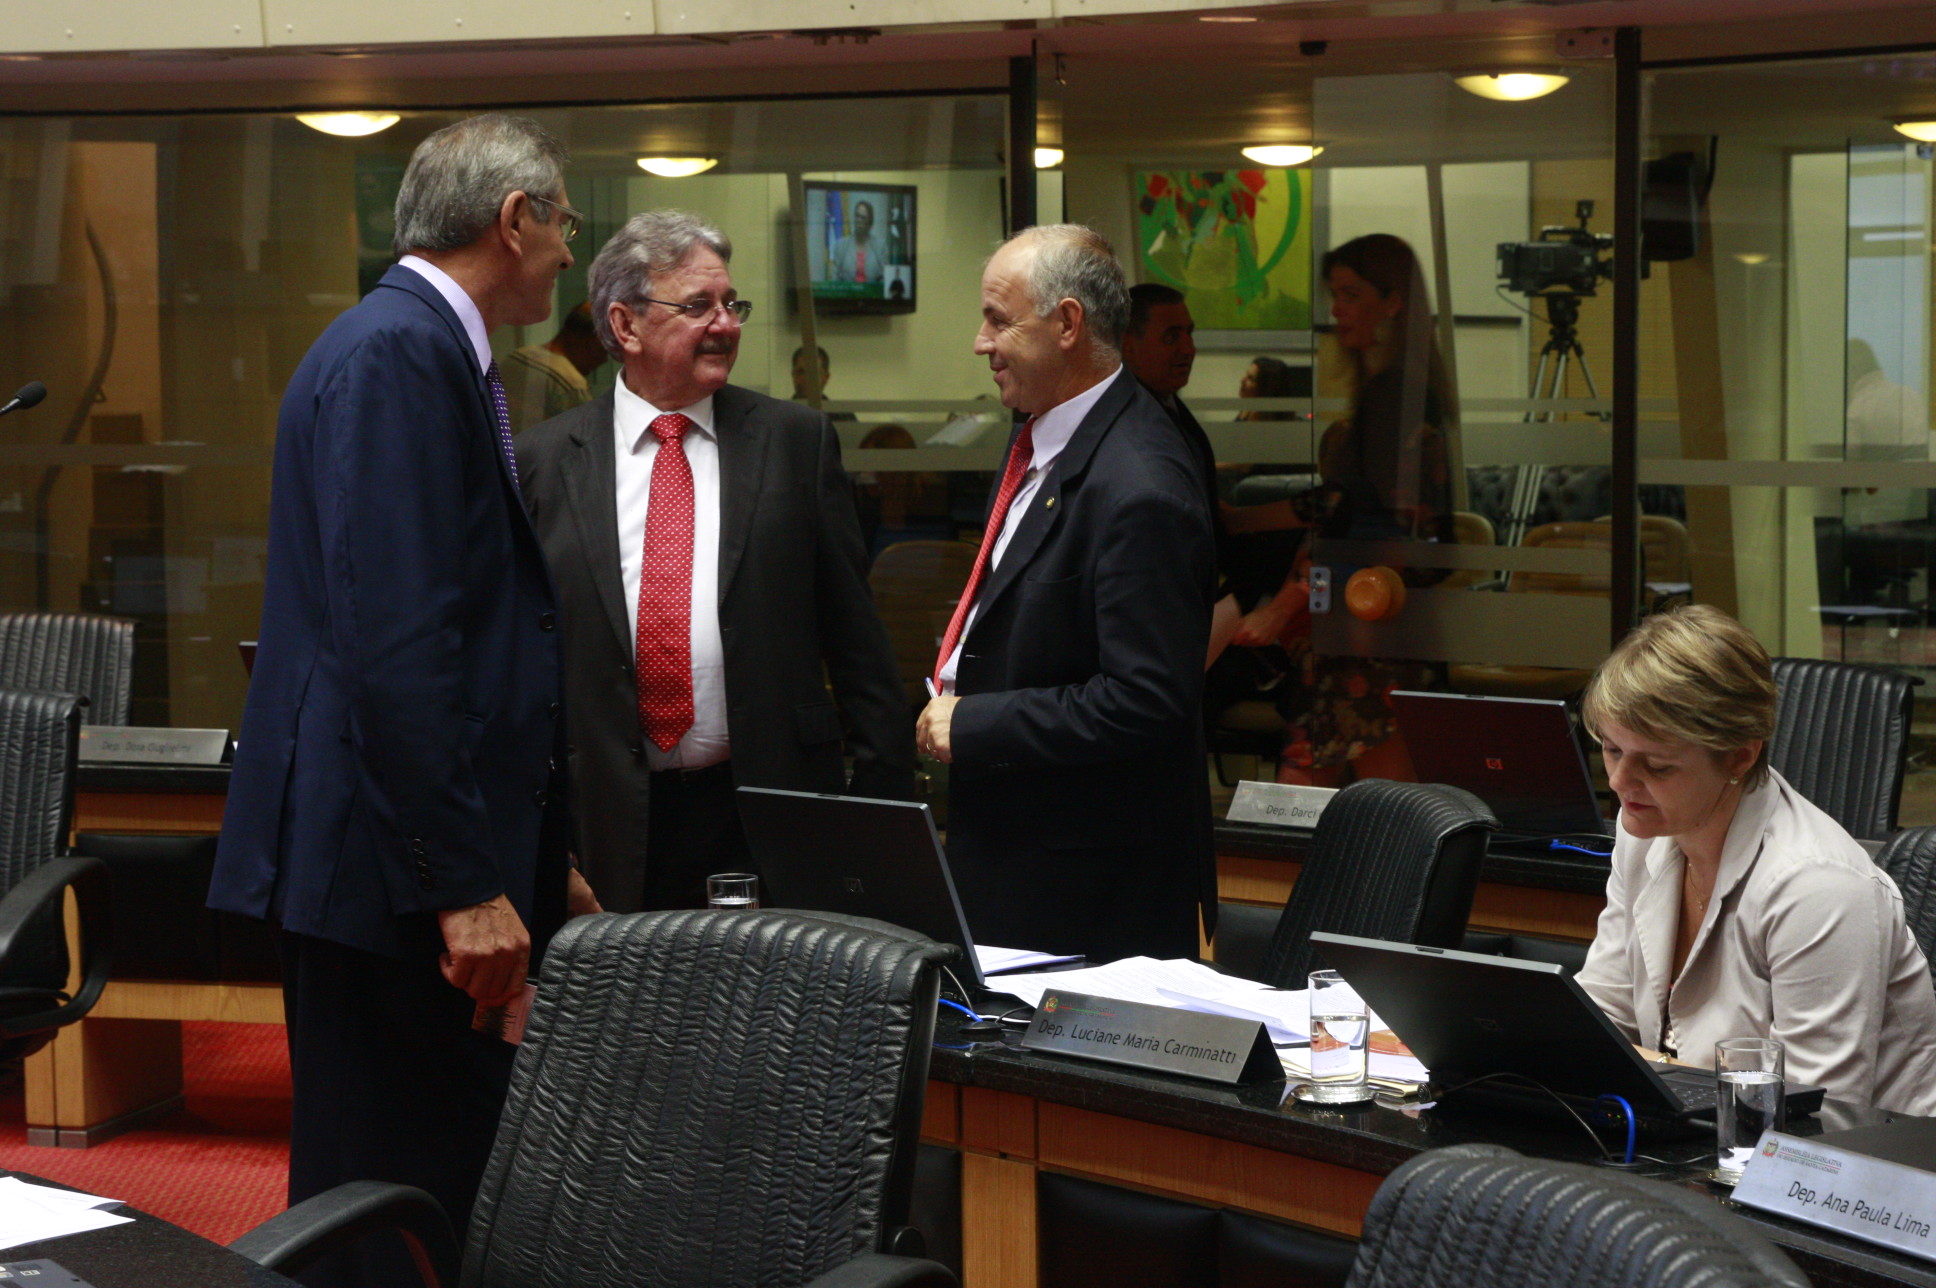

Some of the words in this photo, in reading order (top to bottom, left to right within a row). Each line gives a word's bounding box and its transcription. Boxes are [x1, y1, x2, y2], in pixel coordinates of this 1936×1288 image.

[1266, 804, 1287, 817] Dep.
[1291, 806, 1318, 819] Darci
[1038, 1018, 1065, 1038] Dep.
[1070, 1024, 1121, 1046] Luciane
[1123, 1033, 1160, 1052] Maria
[1163, 1038, 1236, 1064] Carminatti
[1787, 1180, 1817, 1205] Dep.
[1821, 1191, 1850, 1214] Ana
[1852, 1199, 1892, 1227] Paula
[1894, 1211, 1931, 1238] Lima
